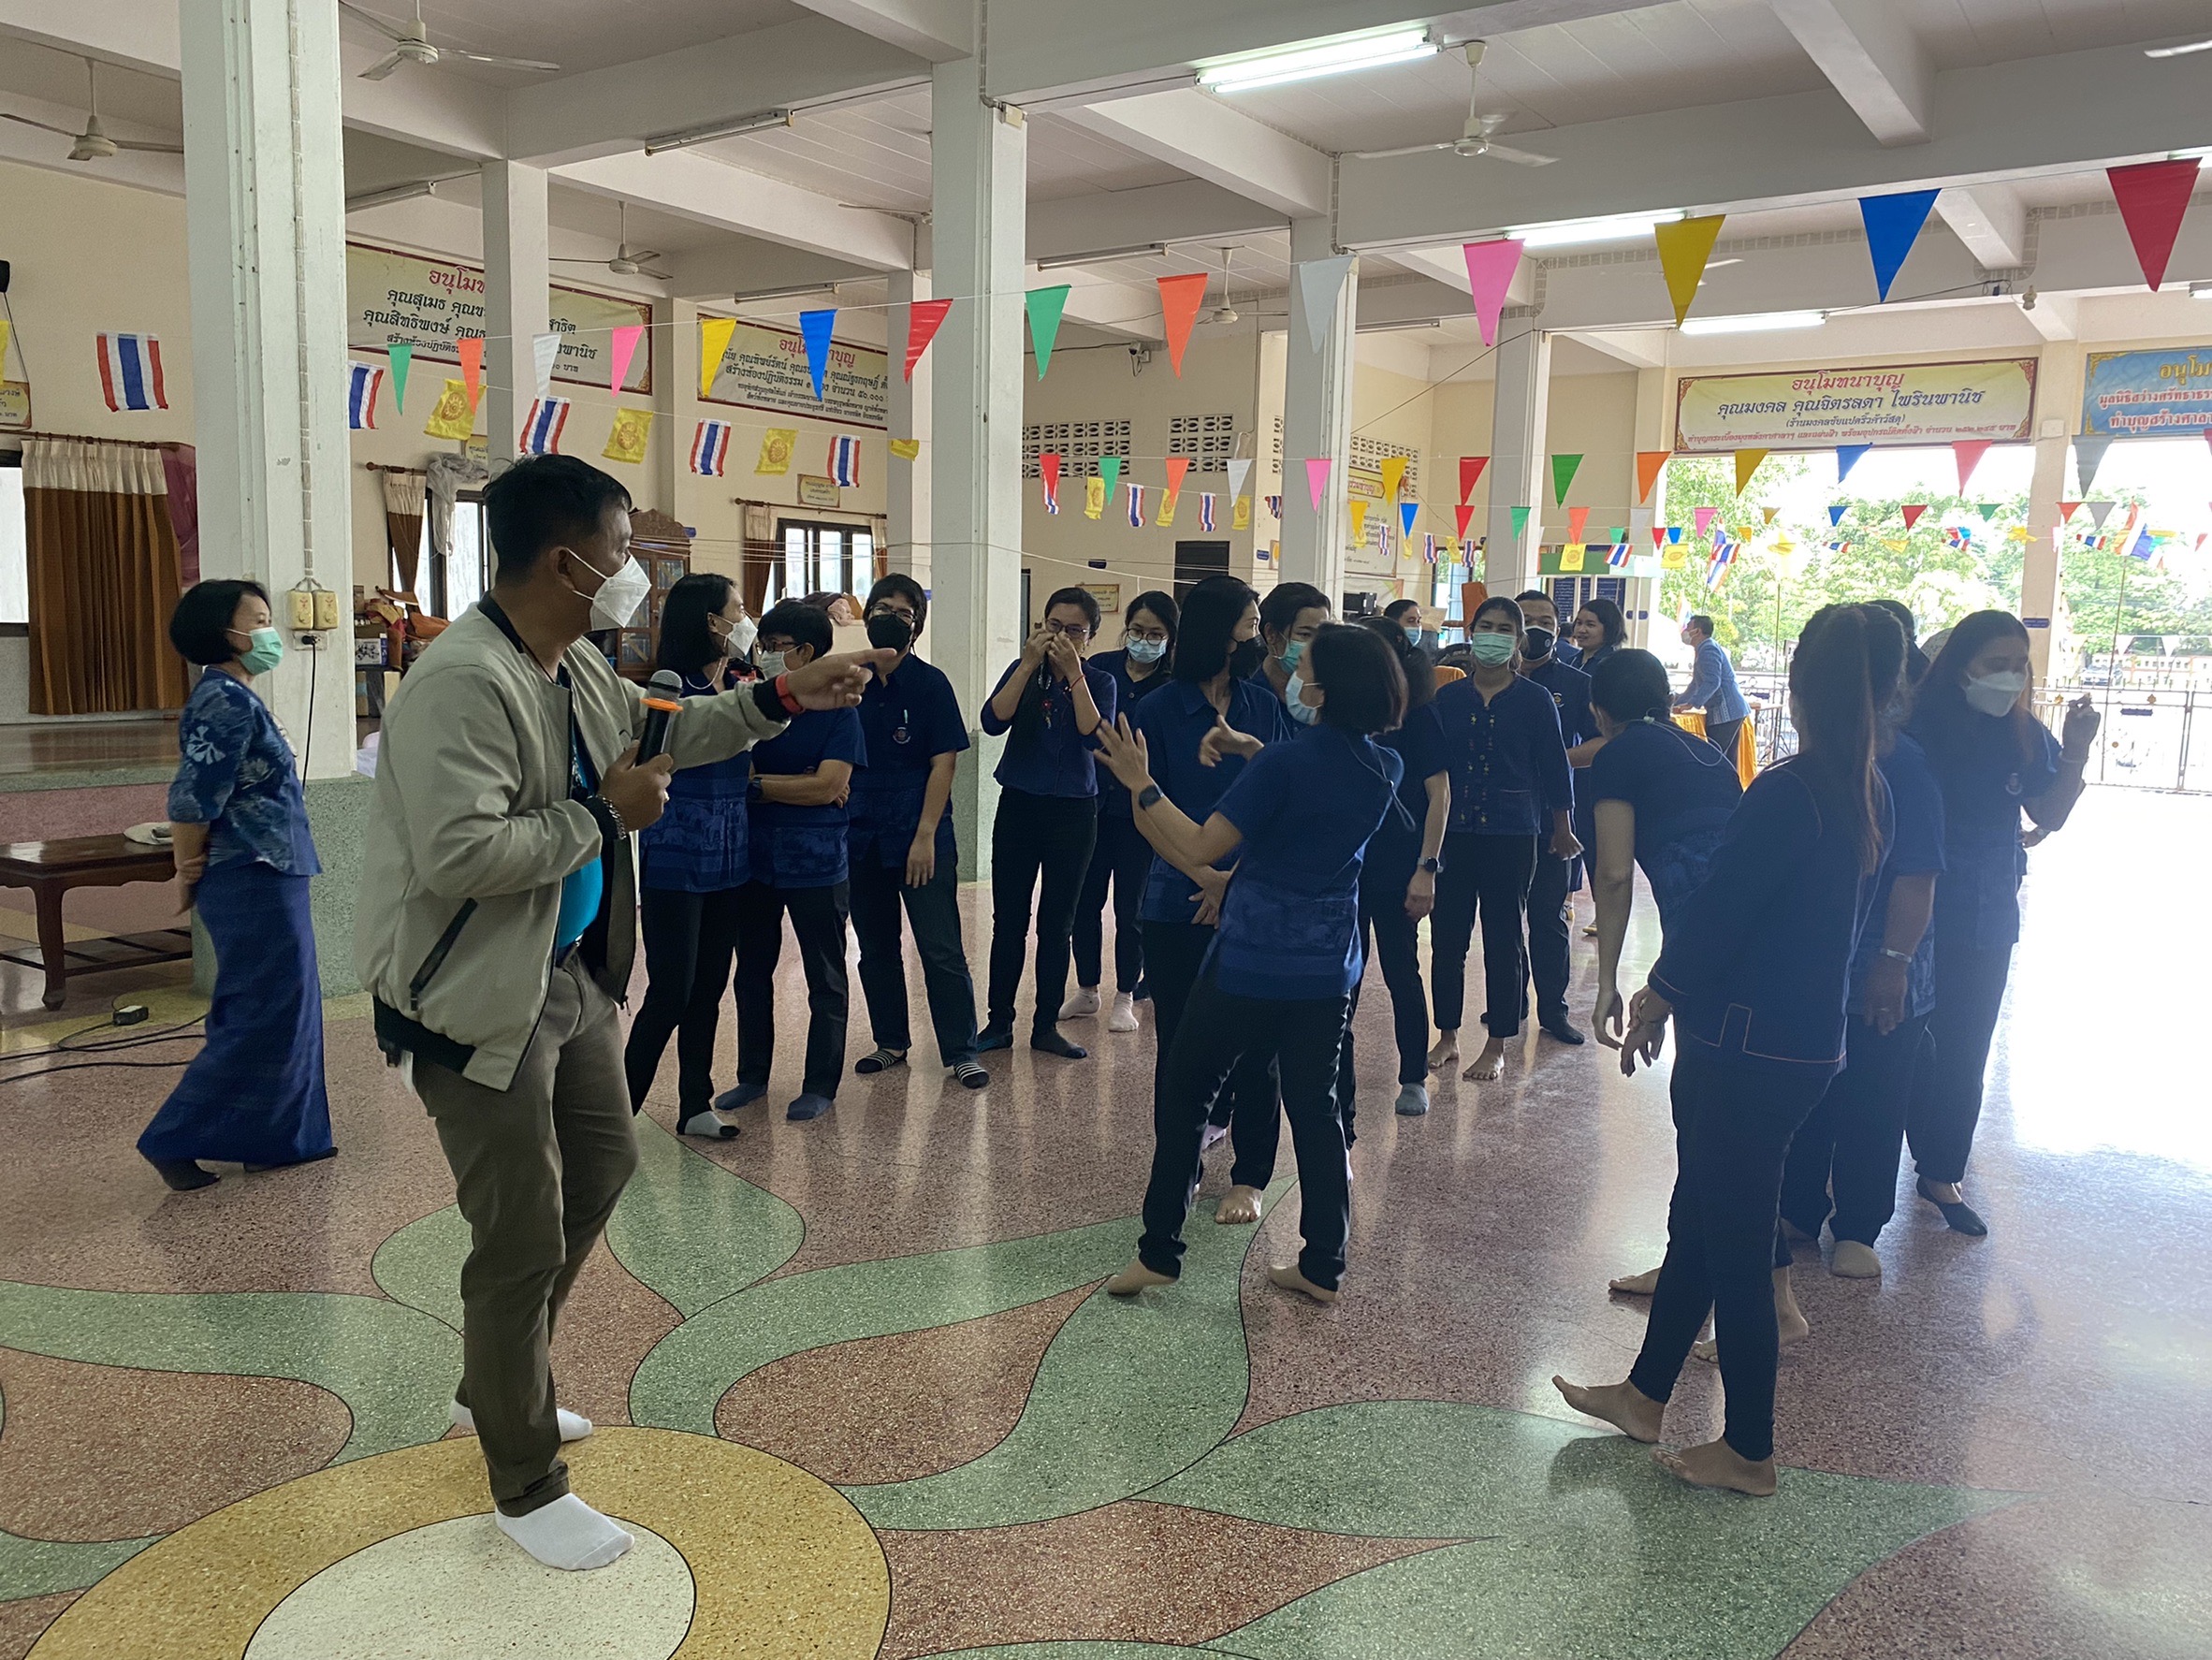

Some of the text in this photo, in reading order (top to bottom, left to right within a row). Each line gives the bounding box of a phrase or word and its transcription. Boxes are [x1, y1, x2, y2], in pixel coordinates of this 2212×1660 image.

[1791, 370, 1905, 395] อนุโมทนาบุญ
[1717, 387, 1986, 419] คุณมงคล คุณจิตรลดา ไพรินพานิช
